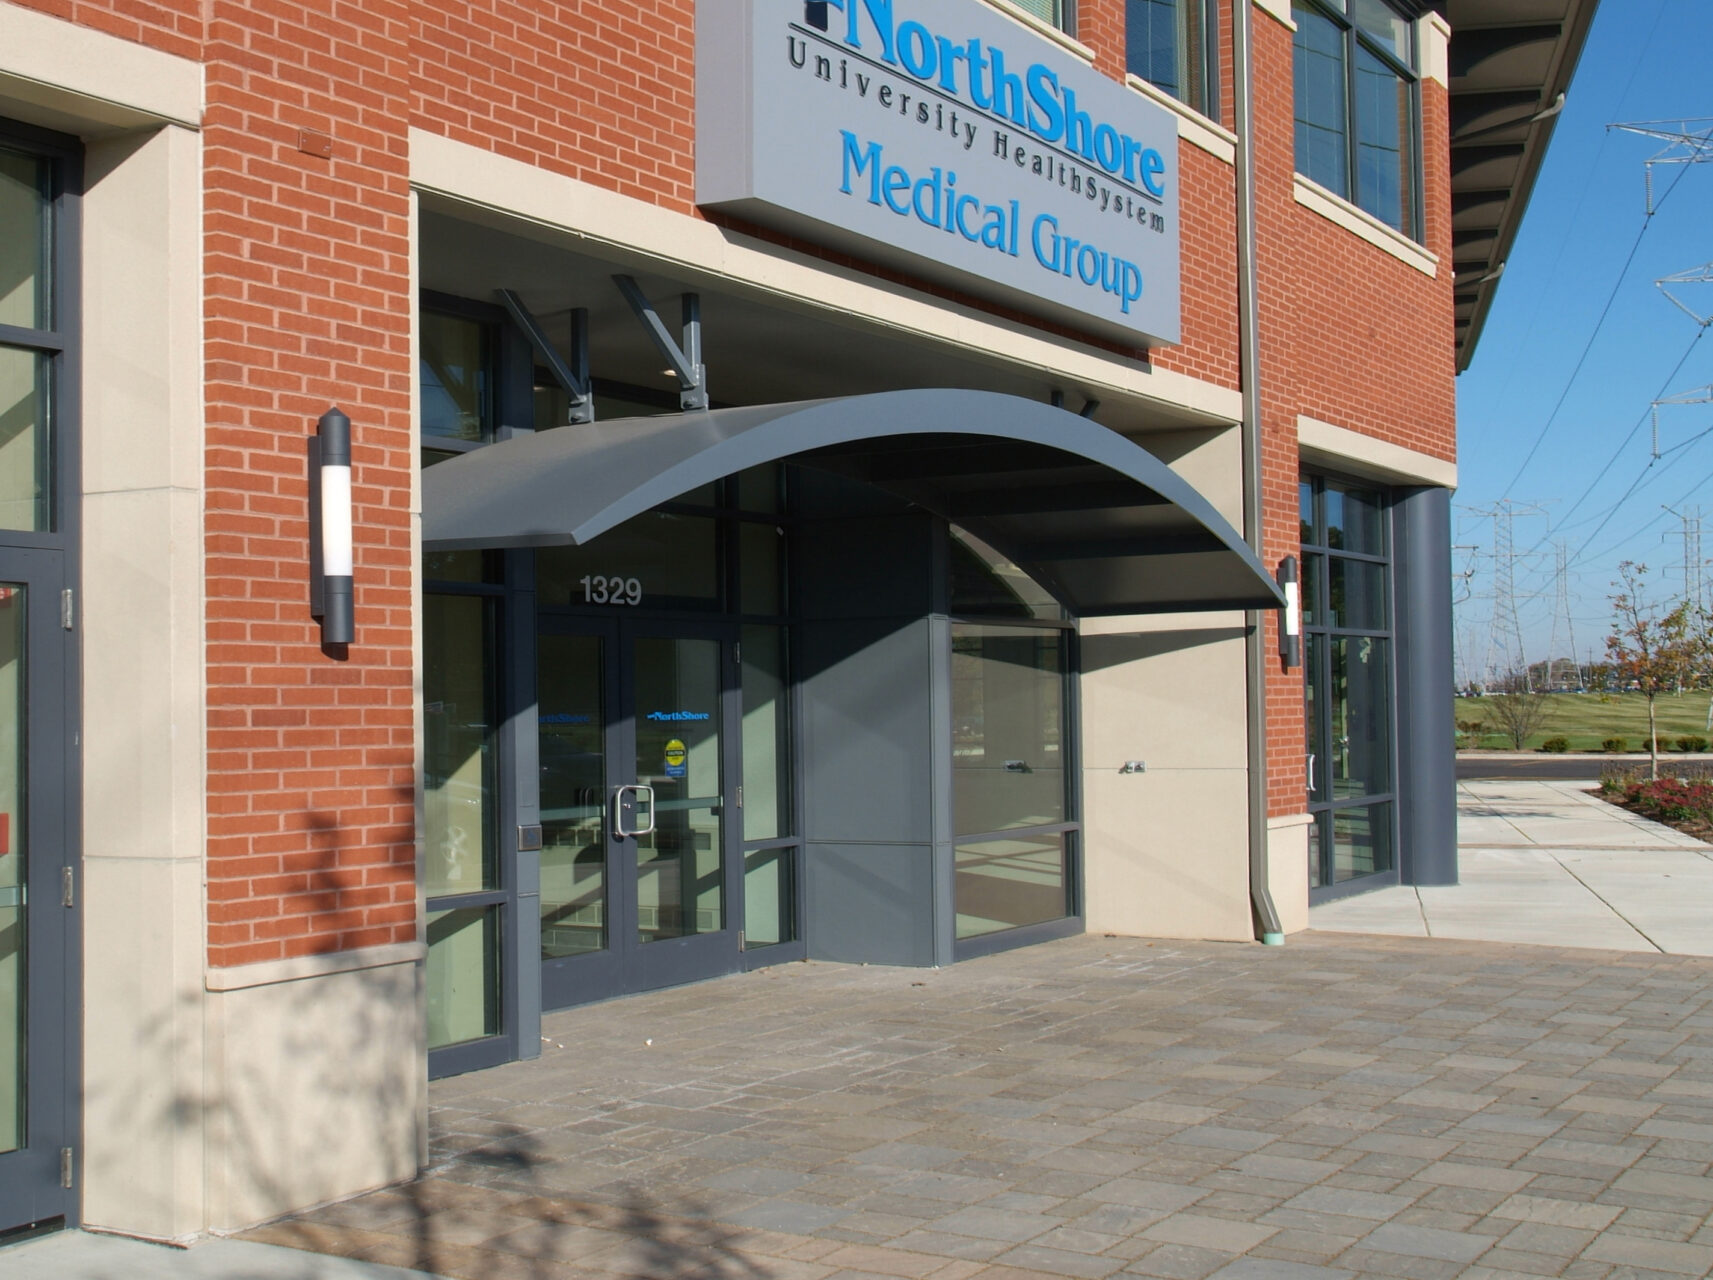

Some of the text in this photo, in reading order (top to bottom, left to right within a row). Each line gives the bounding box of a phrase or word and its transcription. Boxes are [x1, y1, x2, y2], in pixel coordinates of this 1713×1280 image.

[787, 35, 1164, 233] University HealthSystem
[839, 129, 1143, 314] Medical Group
[580, 575, 642, 606] 1329
[654, 710, 709, 721] NorthShore
